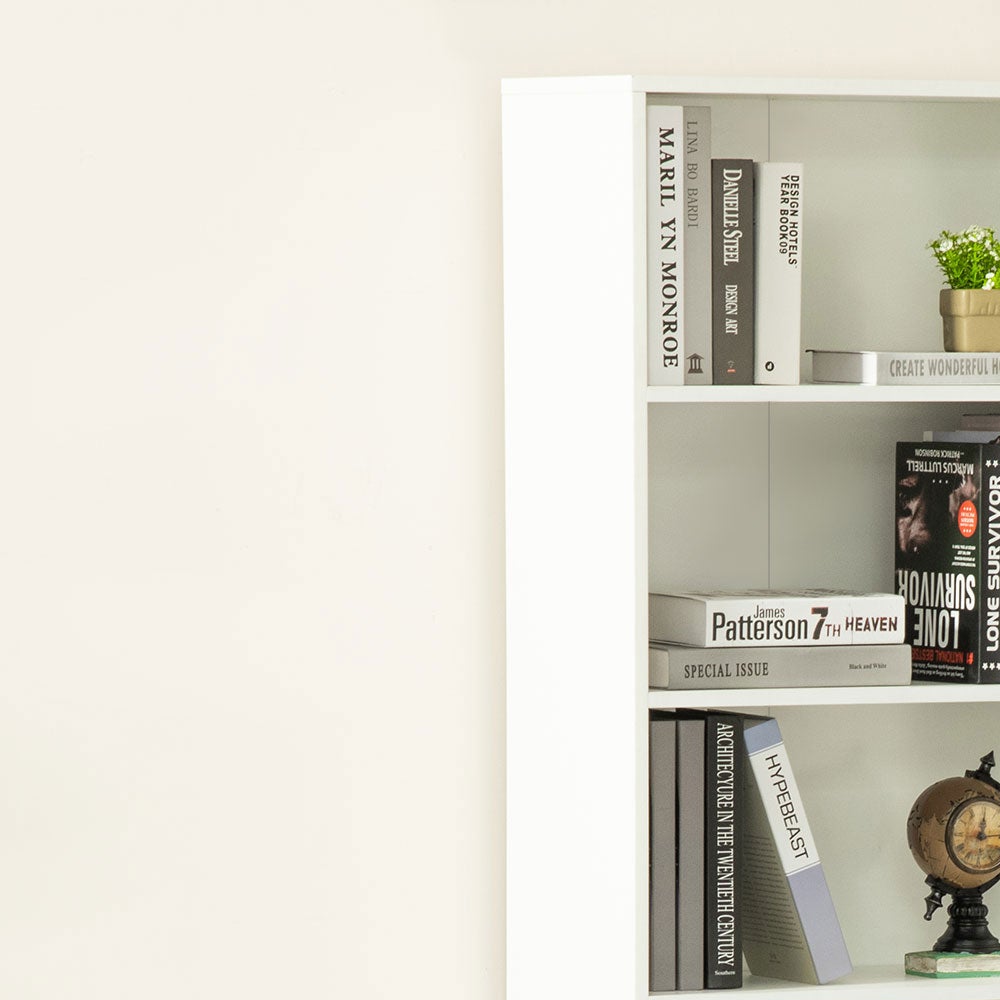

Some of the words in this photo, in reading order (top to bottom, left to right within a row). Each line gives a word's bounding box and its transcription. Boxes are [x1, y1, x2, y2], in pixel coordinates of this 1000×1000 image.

[686, 120, 698, 154] LINA
[659, 127, 676, 207] MARIL
[686, 162, 699, 180] BO
[780, 174, 790, 204] YEAR
[789, 175, 800, 217] DESIGN
[687, 188, 699, 228] BARDI
[660, 217, 677, 251] YN
[788, 222, 799, 265] HOTELS
[661, 261, 679, 368] MONROE
[725, 284, 738, 315] DESIGN
[725, 317, 738, 335] ART
[889, 359, 925, 377] CREATE
[927, 358, 989, 376] WONDERFUL
[906, 460, 942, 473] LUTTRELL
[943, 462, 974, 475] MARCUS
[898, 570, 976, 611] SURVIVOR
[712, 611, 808, 641] Patterson
[753, 604, 785, 619] James
[845, 615, 898, 633] HEAVEN
[986, 596, 1000, 652] LONE
[913, 608, 960, 649] LONE
[684, 663, 732, 679] SPECIAL
[736, 662, 769, 677] ISSUE
[716, 810, 734, 825] IN
[764, 753, 809, 859] HYPEBEAST
[716, 825, 734, 846] THE
[716, 849, 735, 915] TWENTIETH
[716, 915, 735, 967] CENTURY
